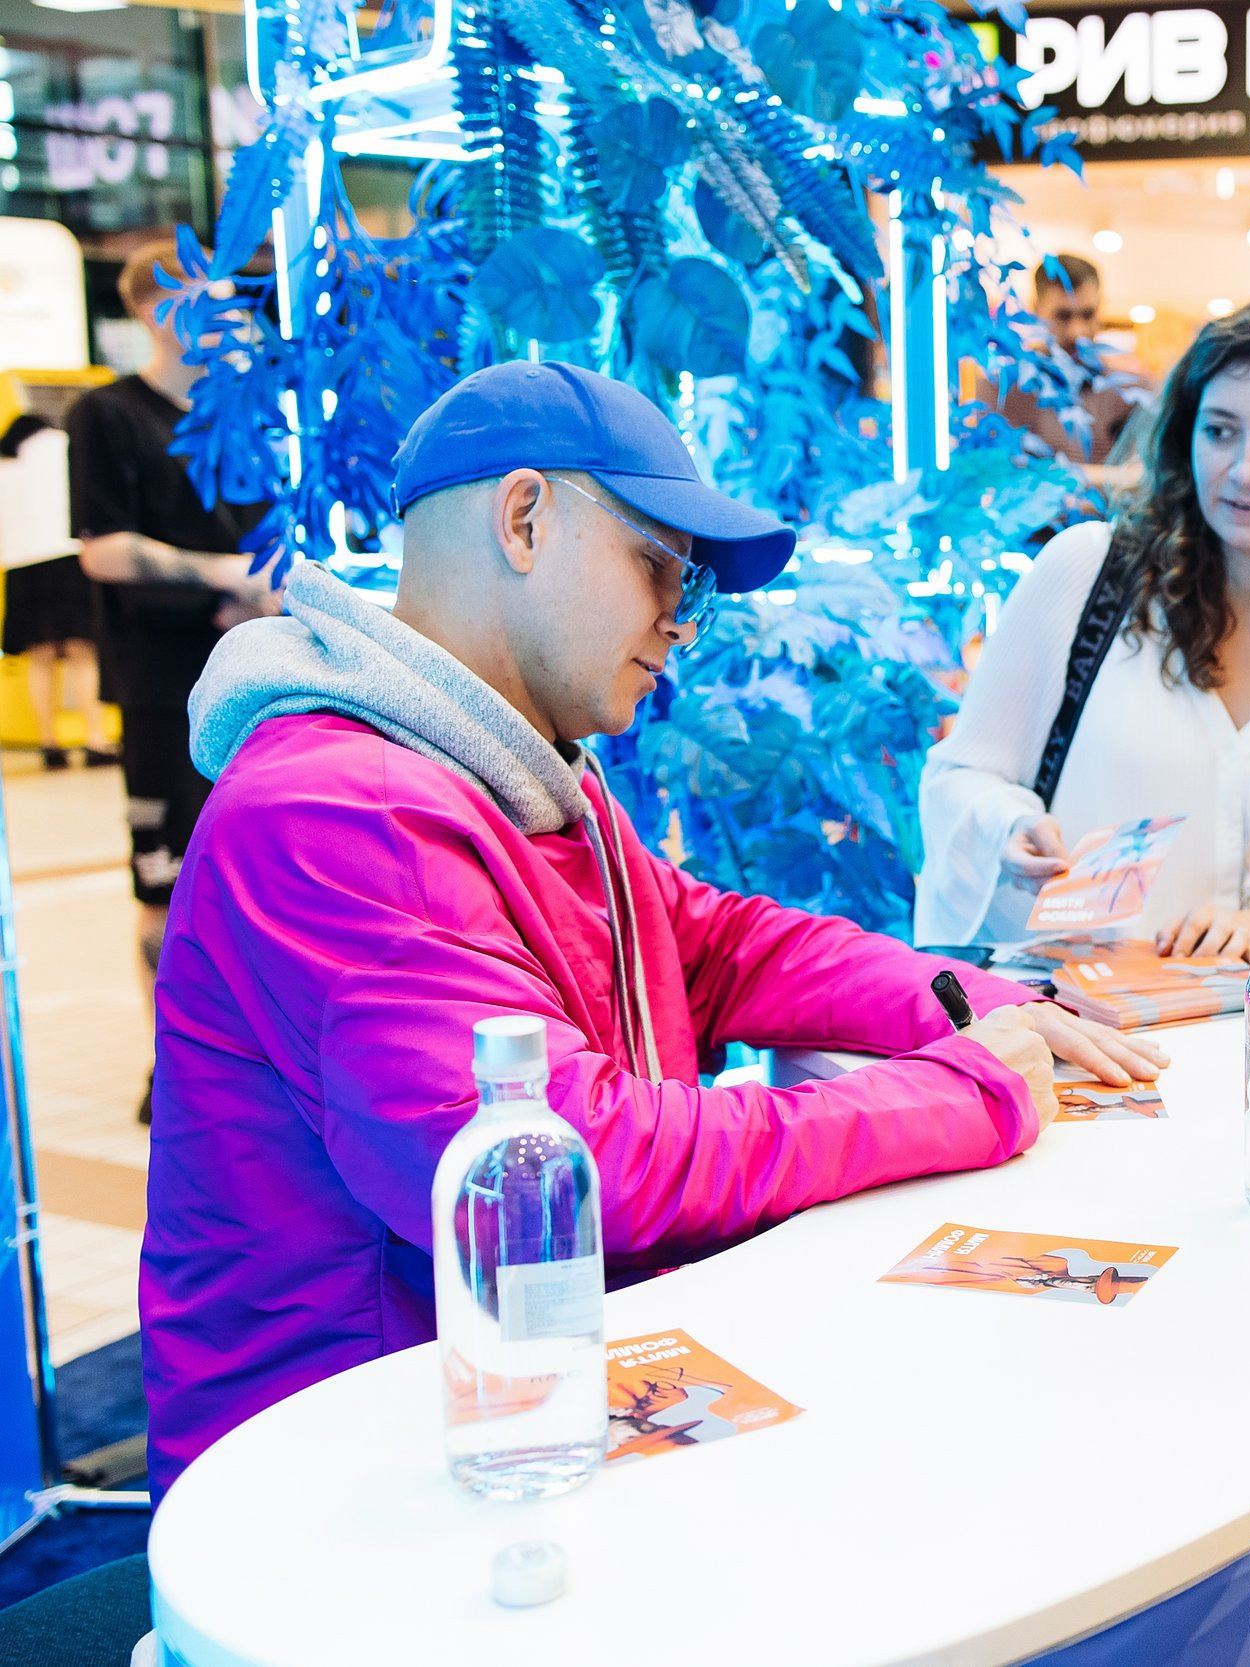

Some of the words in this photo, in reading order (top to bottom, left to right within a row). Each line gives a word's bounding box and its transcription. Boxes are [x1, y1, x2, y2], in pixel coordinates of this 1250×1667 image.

[1016, 12, 1228, 110] РИВ
[1067, 580, 1124, 703] BALLY
[605, 1337, 678, 1360] ФОМИ
[618, 1345, 692, 1368] МИТЯ
